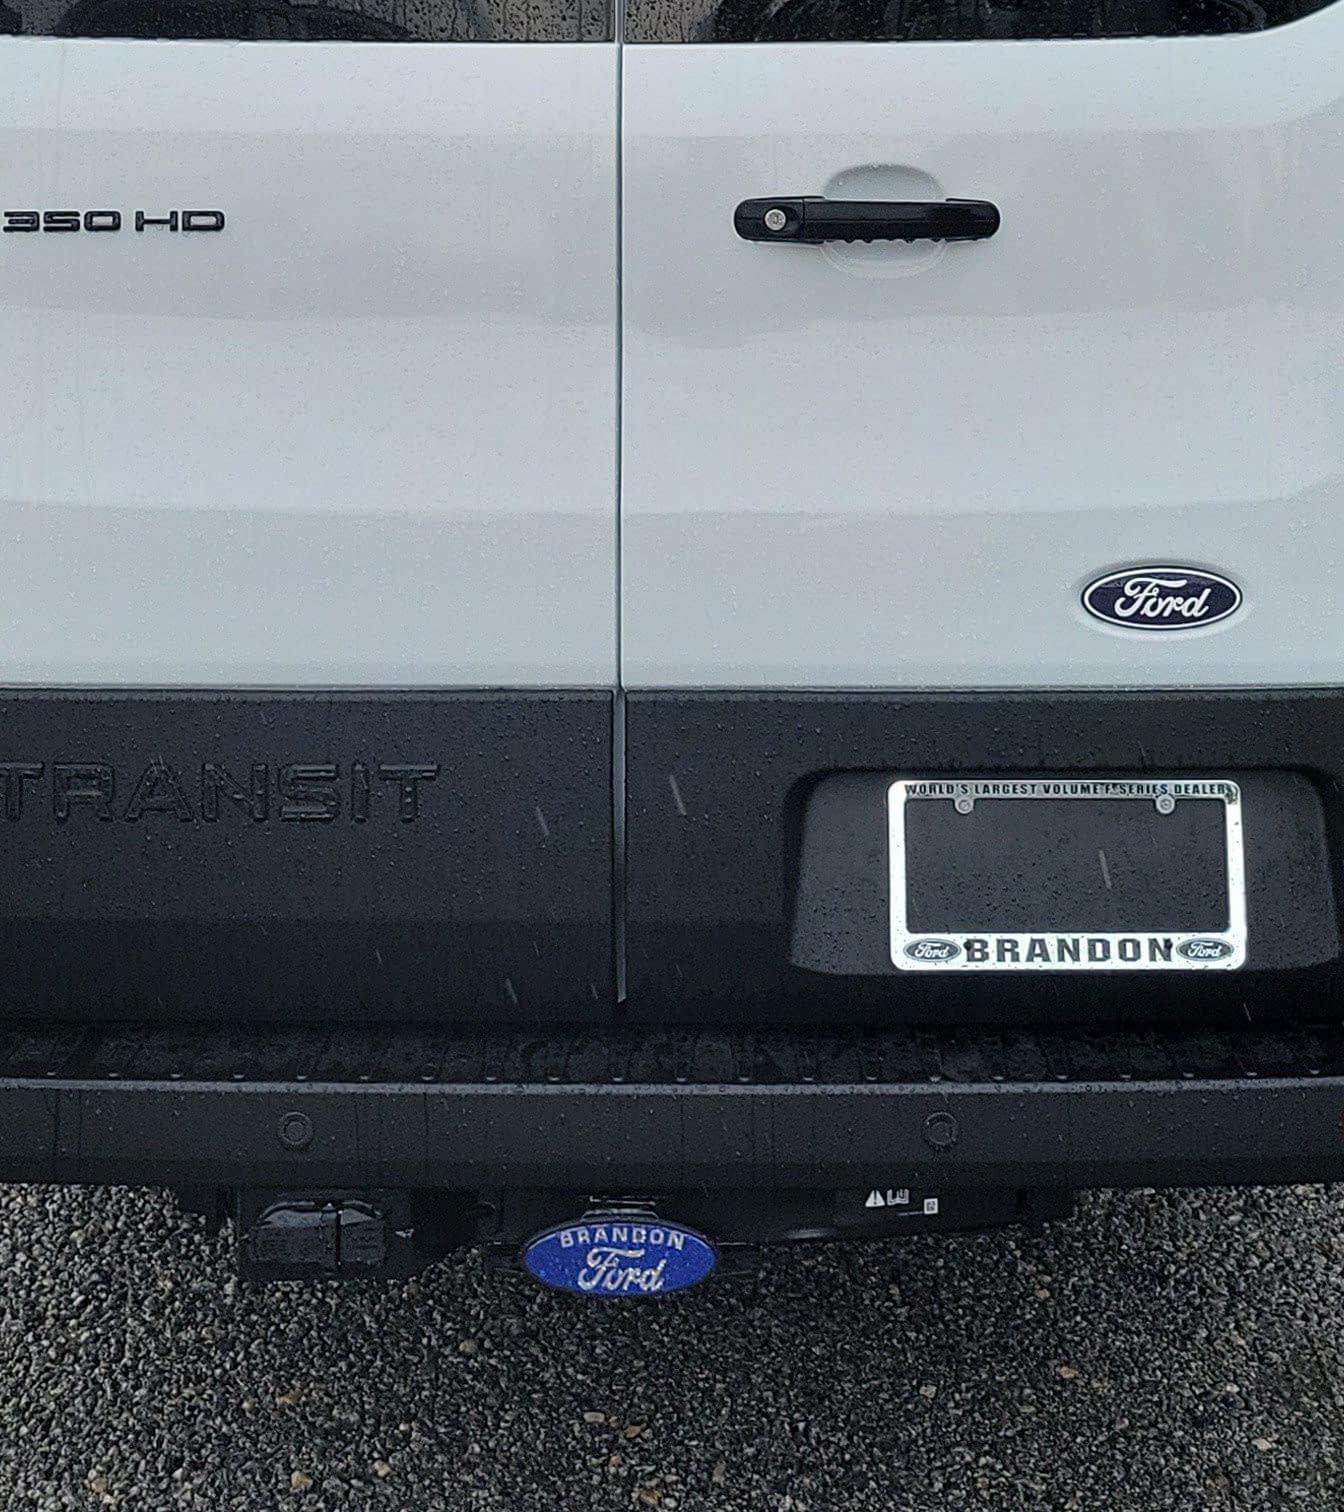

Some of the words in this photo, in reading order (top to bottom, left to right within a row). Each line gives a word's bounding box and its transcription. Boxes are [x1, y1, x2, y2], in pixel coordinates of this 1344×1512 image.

[2, 210, 122, 233] 350
[134, 210, 226, 232] HD
[1113, 576, 1212, 618] Ford
[904, 783, 969, 795] WORLD'S
[974, 783, 1037, 795] LARGEST
[1042, 783, 1099, 795] VOLUME
[1105, 783, 1168, 795] FSERIES
[965, 937, 1174, 963] BRANDON
[559, 1226, 686, 1251] BRANDON
[577, 1246, 667, 1291] Ford
